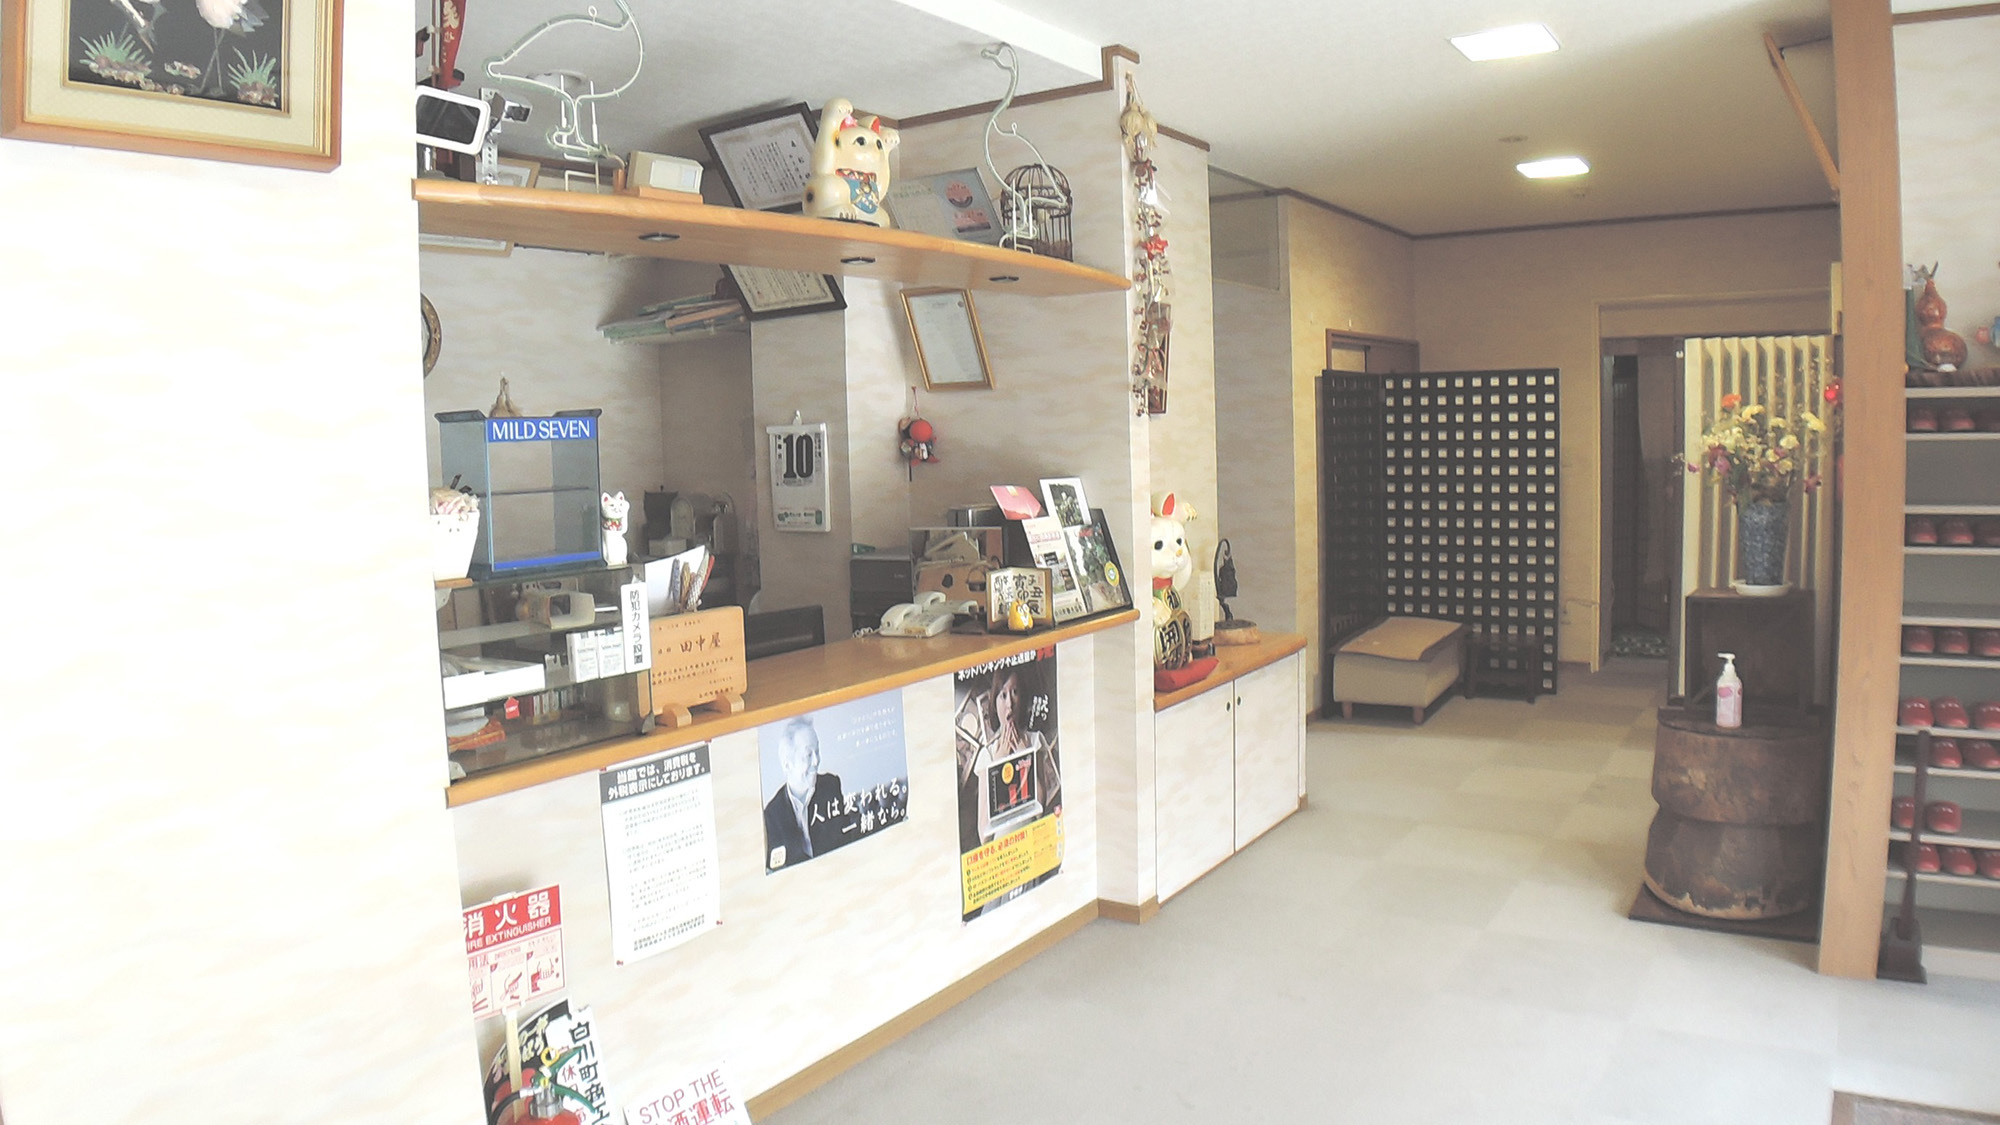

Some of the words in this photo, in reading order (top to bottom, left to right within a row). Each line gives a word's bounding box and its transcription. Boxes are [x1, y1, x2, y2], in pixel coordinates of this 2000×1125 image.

[492, 421, 537, 440] MILD
[539, 420, 591, 440] SEVEN
[783, 433, 814, 479] 10
[629, 589, 643, 665] 防犯カメラ設置
[810, 777, 908, 827] 人は変われる。
[841, 801, 905, 834] 一緒なら。
[463, 890, 550, 940] 消火器
[466, 937, 484, 952] IRE
[485, 916, 552, 946] EXTINGUISHER
[639, 1088, 685, 1125] STOP
[688, 1068, 724, 1098] THE
[655, 1088, 735, 1125] 酒運転
